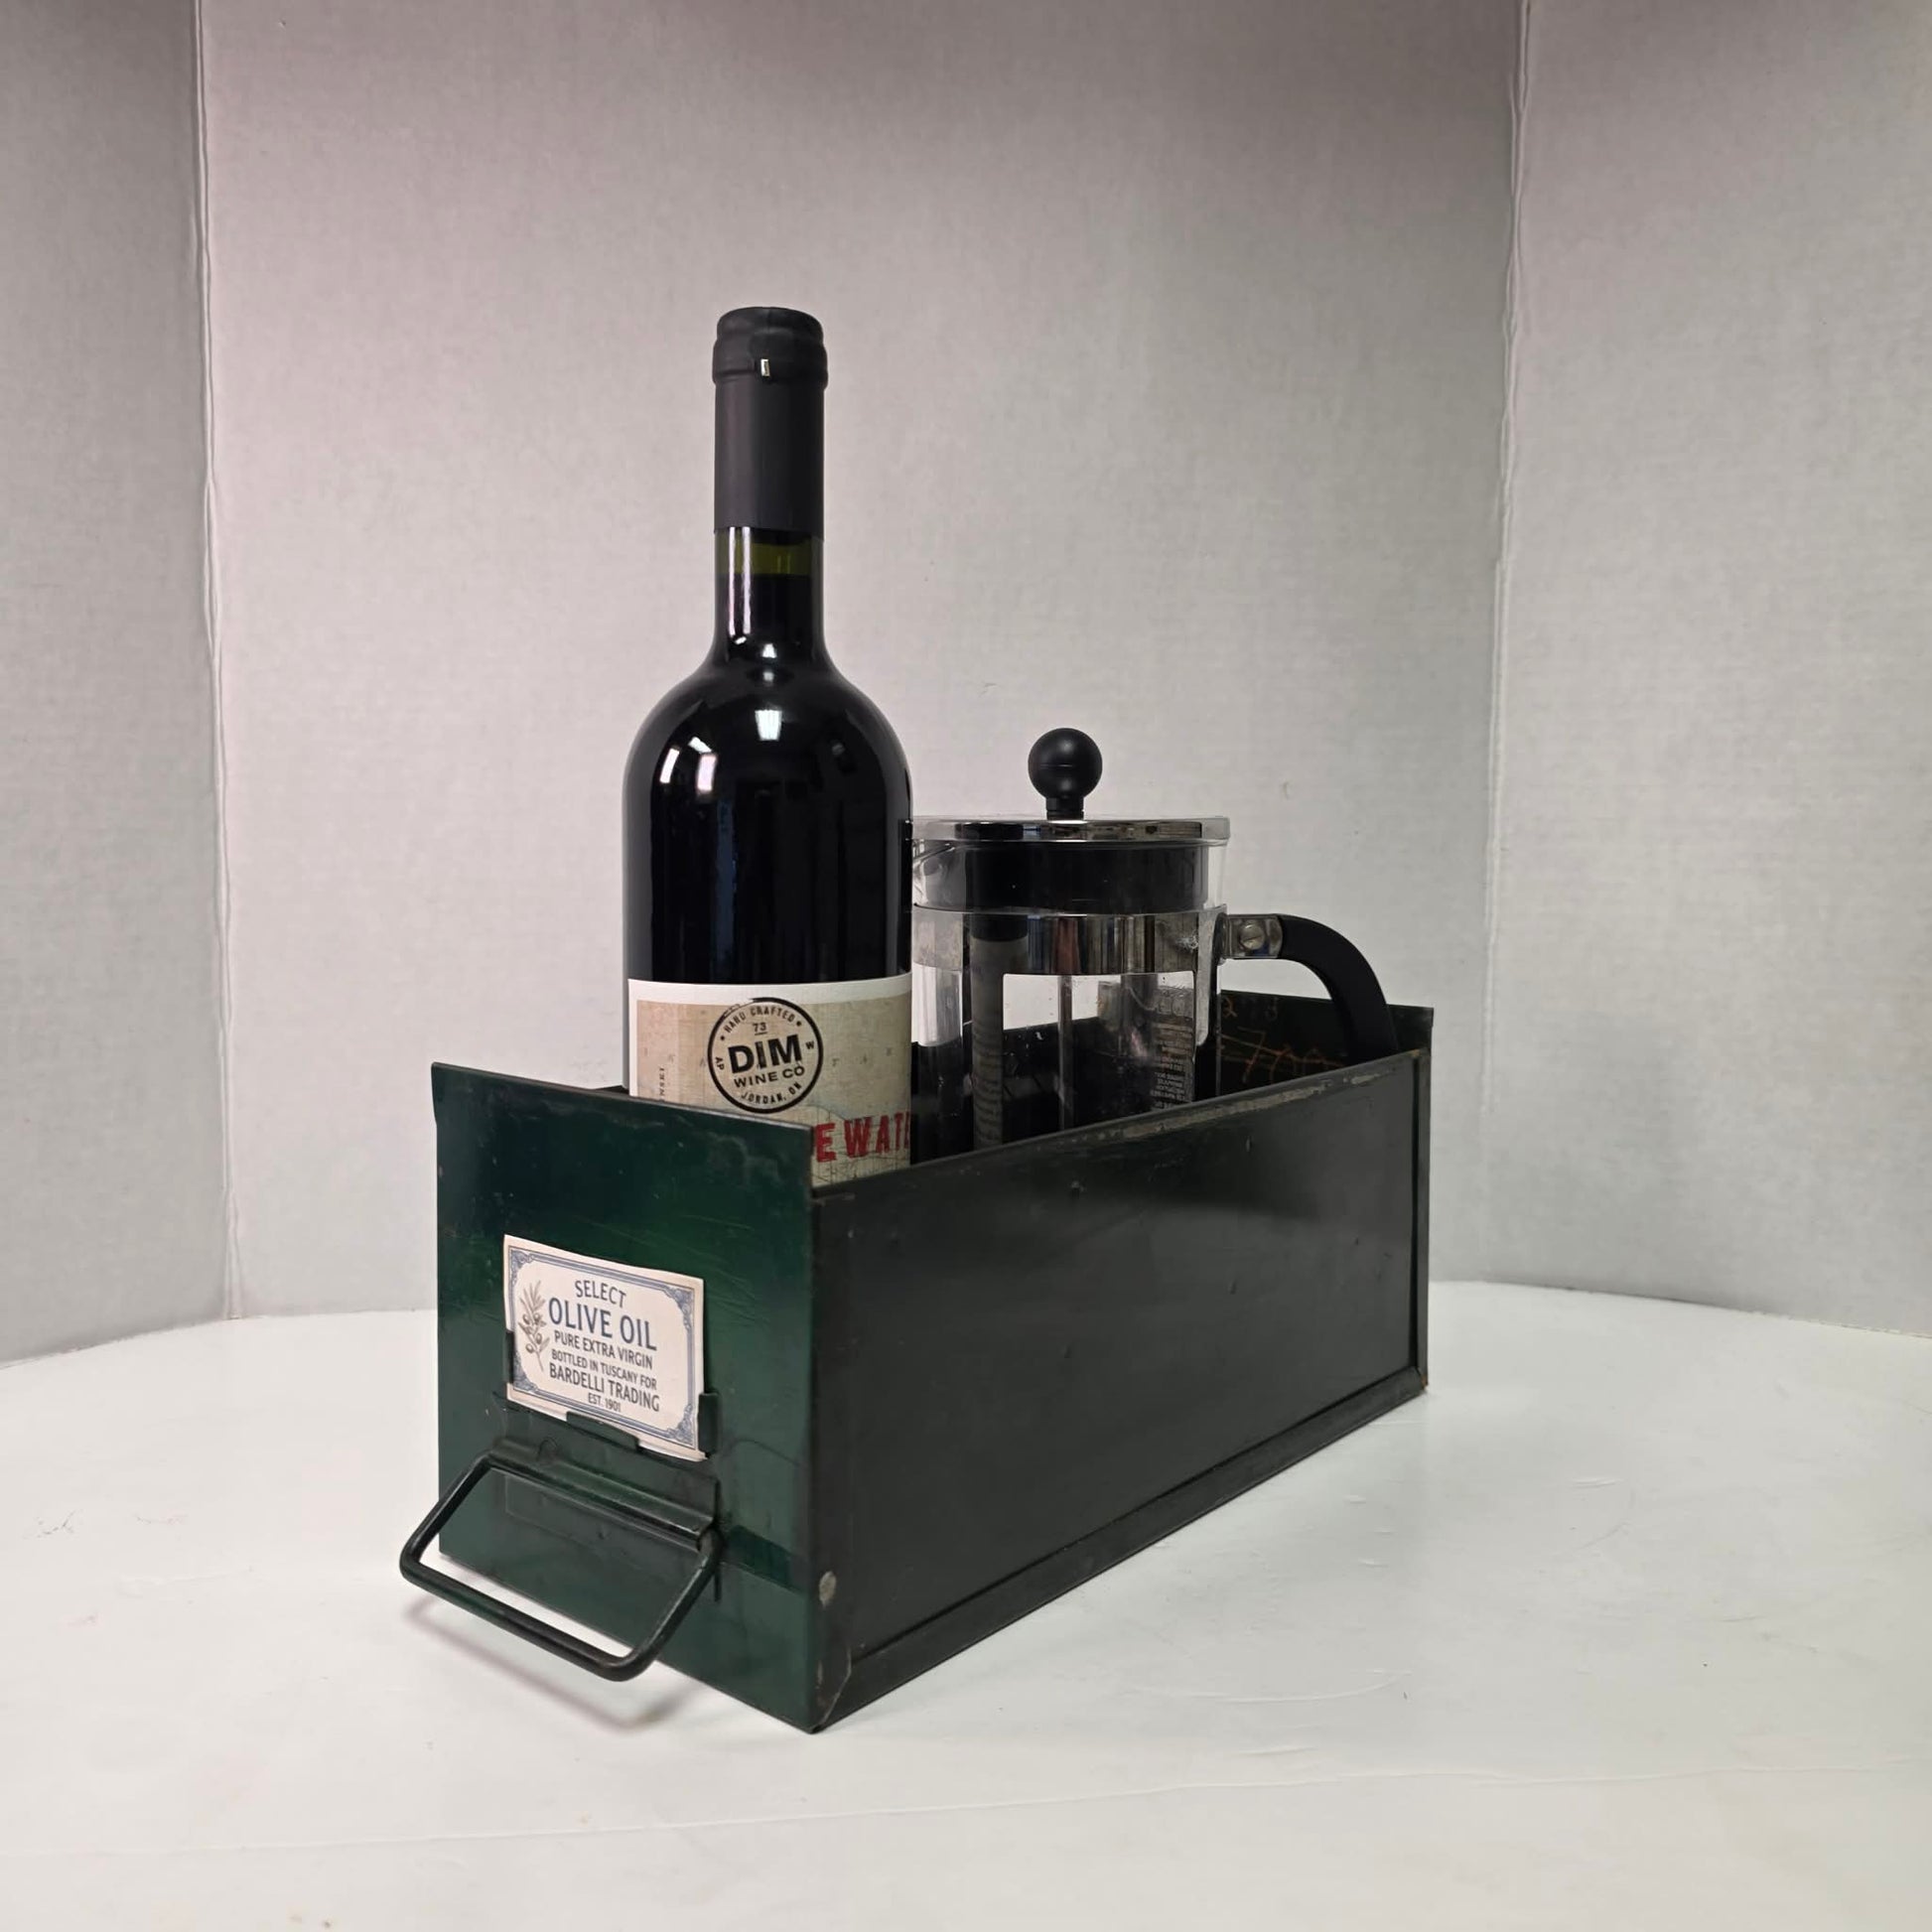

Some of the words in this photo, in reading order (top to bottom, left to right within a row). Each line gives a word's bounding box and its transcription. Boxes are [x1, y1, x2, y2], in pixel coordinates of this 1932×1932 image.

[723, 1011, 747, 1034] HAND
[750, 1005, 796, 1023] CRAFTED
[752, 1022, 767, 1033] 73
[728, 1034, 803, 1074] DIM
[734, 1071, 779, 1088] WINE
[781, 1065, 805, 1079] CO
[787, 1081, 802, 1095] ON
[575, 1280, 626, 1309] SELECT
[548, 1297, 613, 1338] OLIVE
[620, 1314, 657, 1351] OIL
[554, 1329, 581, 1350] PURE
[583, 1337, 616, 1358] EXTRA
[618, 1345, 653, 1370] VIRGIN
[552, 1349, 588, 1369] BOTTLED
[589, 1358, 599, 1371] IN
[601, 1361, 640, 1385] TUSCANY
[640, 1374, 657, 1391] FOR
[549, 1362, 605, 1393] BARDELLI
[608, 1379, 660, 1412] TRADING
[588, 1393, 604, 1408] EST.
[605, 1397, 621, 1412] 1901
